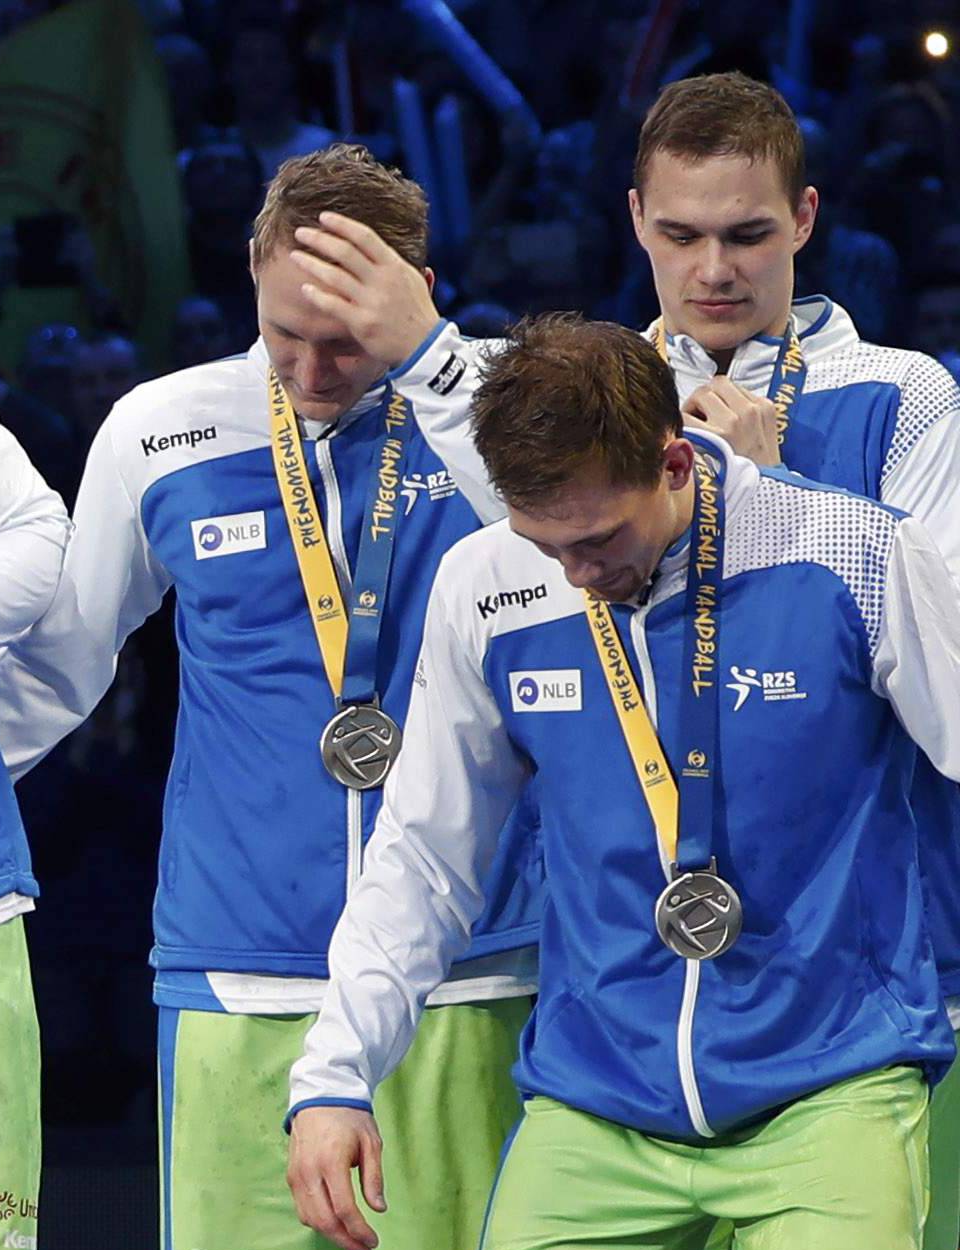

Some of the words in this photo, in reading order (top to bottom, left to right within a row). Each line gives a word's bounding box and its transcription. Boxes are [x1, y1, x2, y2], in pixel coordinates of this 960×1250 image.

[141, 426, 217, 456] Kempa
[370, 438, 403, 543] HANDBALL
[227, 523, 261, 543] NLB
[691, 585, 717, 698] HANDBALL
[543, 682, 577, 699] NLB
[762, 671, 796, 688] RZS
